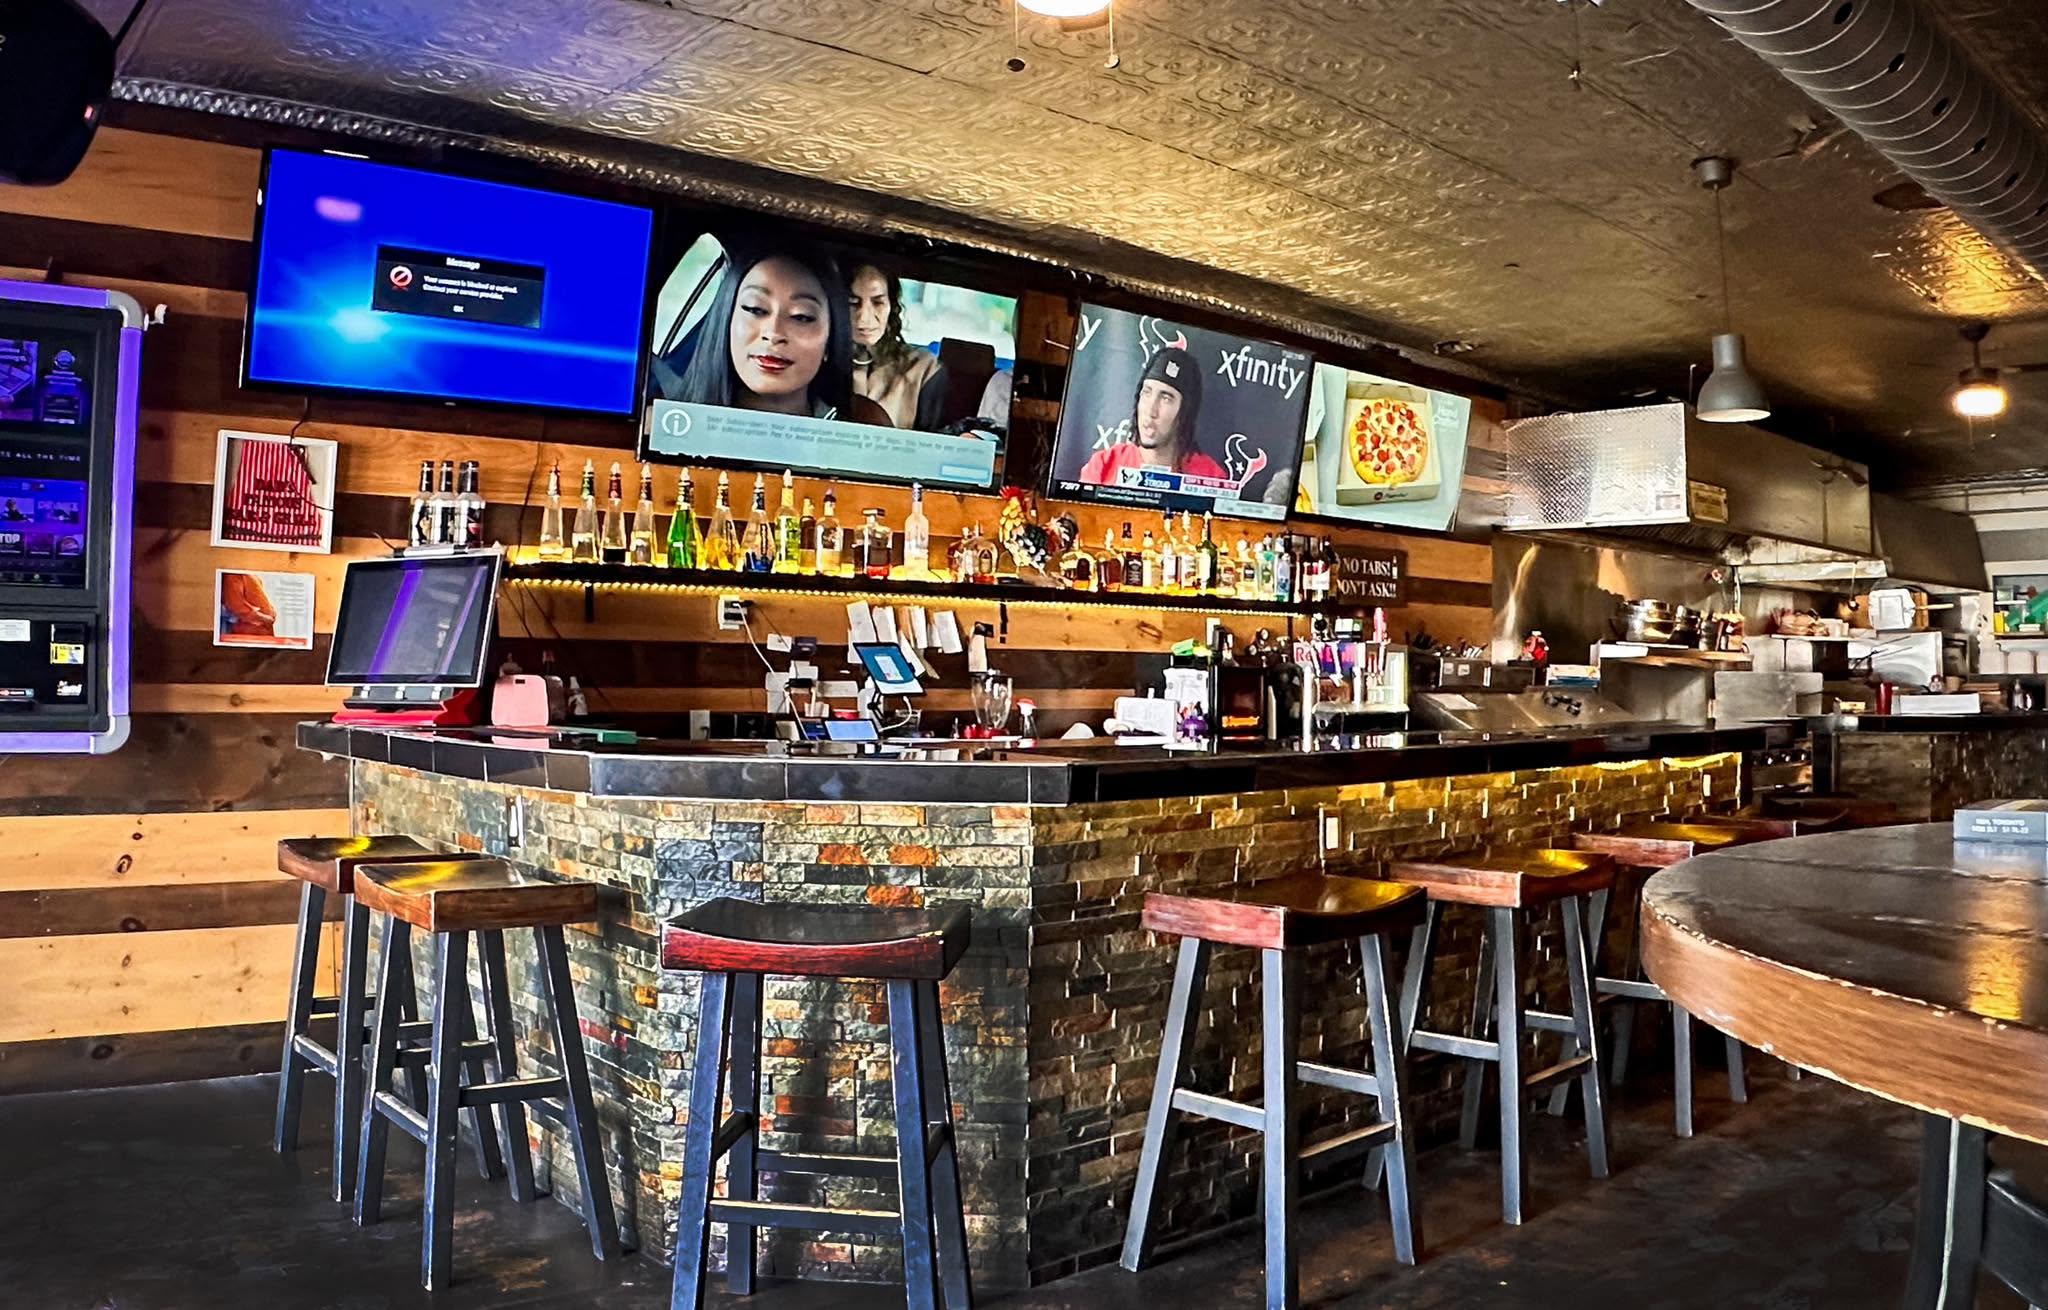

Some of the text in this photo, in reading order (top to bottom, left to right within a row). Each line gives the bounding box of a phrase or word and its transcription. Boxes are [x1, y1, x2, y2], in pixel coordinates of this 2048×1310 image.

[1216, 346, 1306, 400] xfinity
[1060, 481, 1081, 492] TSN
[1342, 557, 1391, 577] NO TABS!
